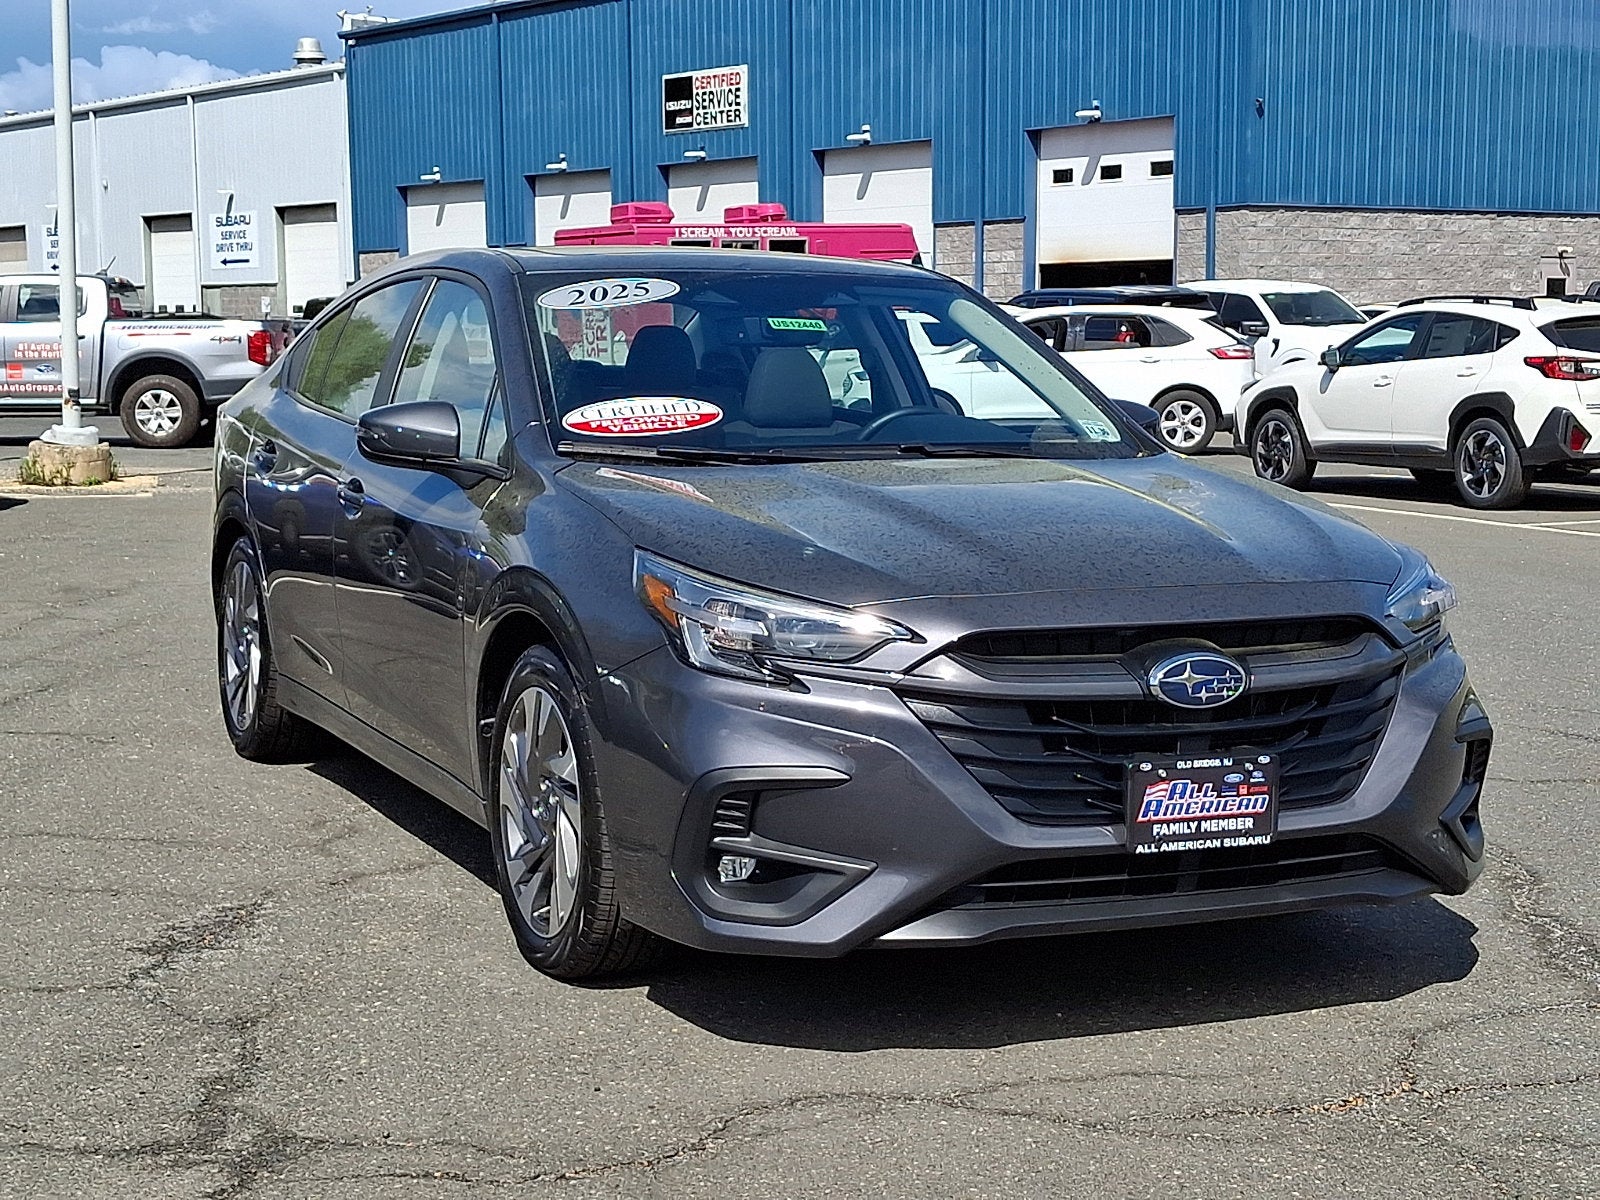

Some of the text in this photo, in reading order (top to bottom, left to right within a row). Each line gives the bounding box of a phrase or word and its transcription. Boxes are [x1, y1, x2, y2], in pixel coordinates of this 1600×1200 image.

[695, 72, 741, 90] CERTIFIED
[666, 100, 692, 110] ISUZU
[695, 87, 741, 110] SERVICE
[695, 109, 741, 126] CENTER
[215, 214, 251, 227] SUBARU
[221, 230, 247, 240] SERVICE
[675, 227, 799, 238] I SCREAM. YOU SCREAM.
[216, 242, 253, 252] DRIVE THRU
[567, 281, 650, 306] 2025
[30, 342, 51, 352] Auto
[24, 350, 39, 358] the
[581, 401, 701, 419] CERTIFIED
[589, 413, 701, 428] PRE-OWNED
[608, 419, 690, 432] VEHICLE
[1176, 760, 1193, 770] OLD
[1152, 817, 1254, 837] FAMILY MEMBER
[1135, 834, 1272, 855] ALL AMERICAN SUBARU
